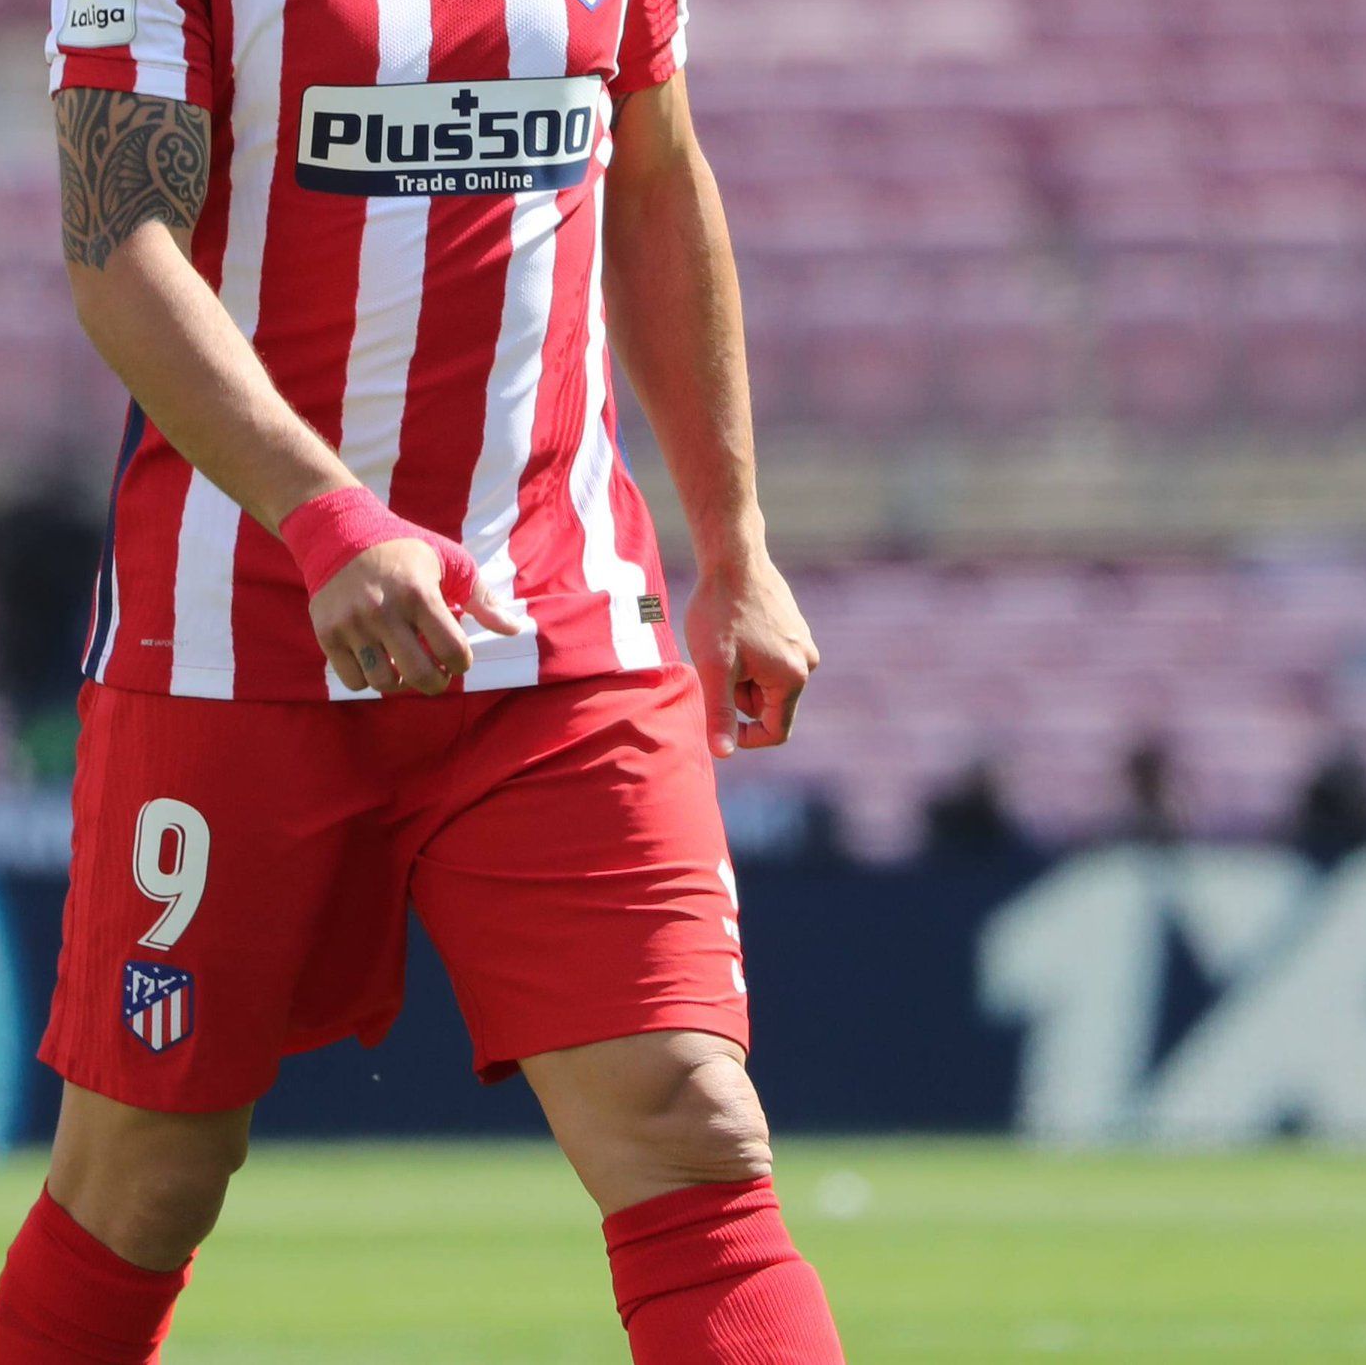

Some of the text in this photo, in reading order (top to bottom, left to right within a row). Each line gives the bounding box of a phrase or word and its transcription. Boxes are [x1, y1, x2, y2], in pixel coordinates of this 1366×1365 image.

[310, 106, 591, 163] Plus500
[395, 171, 533, 192] Trade Online
[133, 797, 210, 951] 9
